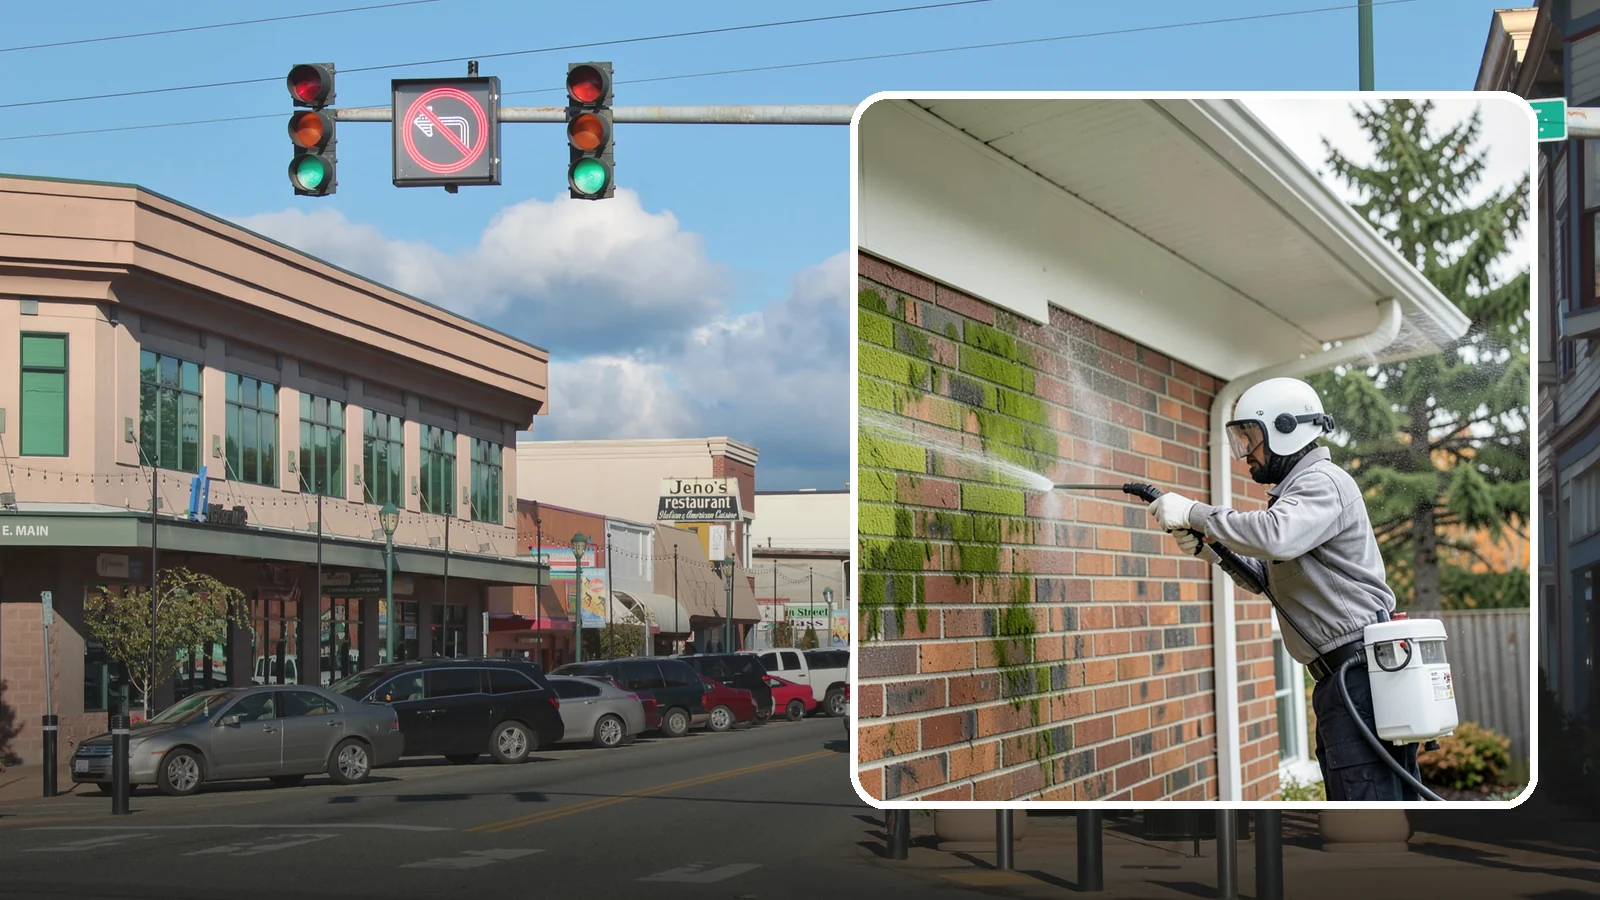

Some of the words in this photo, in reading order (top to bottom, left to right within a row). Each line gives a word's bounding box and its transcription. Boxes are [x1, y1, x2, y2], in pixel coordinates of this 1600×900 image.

[670, 480, 728, 494] Jeno's
[665, 496, 731, 509] restaurant
[658, 510, 681, 519] Italian
[686, 509, 714, 519] American
[715, 509, 738, 519] Cuisine
[2, 525, 13, 536] E.
[15, 525, 49, 537] MAIN
[797, 607, 828, 617] Street
